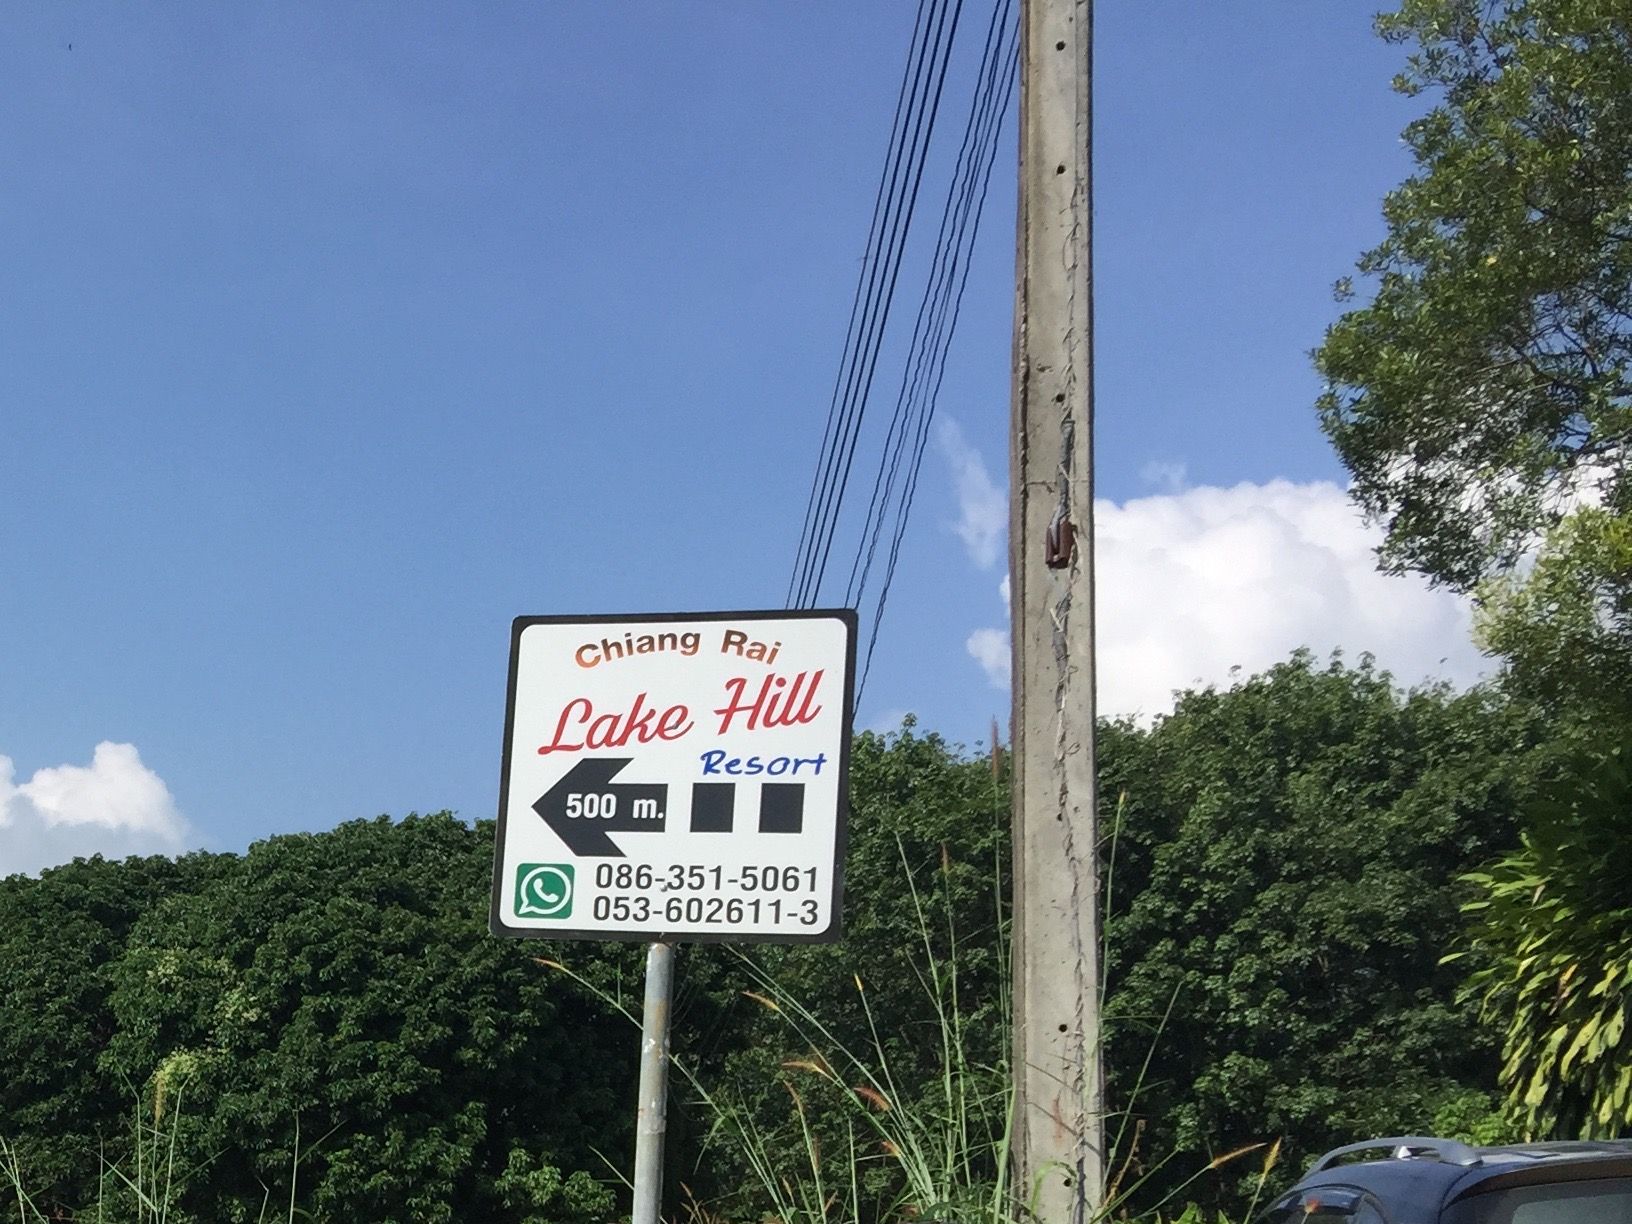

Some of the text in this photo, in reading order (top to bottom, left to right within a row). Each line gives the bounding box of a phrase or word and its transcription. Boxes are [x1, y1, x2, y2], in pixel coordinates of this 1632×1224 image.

[575, 629, 782, 669] Chiang Rai
[537, 669, 825, 755] Lake Hill
[700, 749, 828, 776] Resort
[565, 792, 665, 820] 500 m.
[594, 863, 819, 893] 086-351-5061
[592, 895, 820, 926] 053-602611-3
